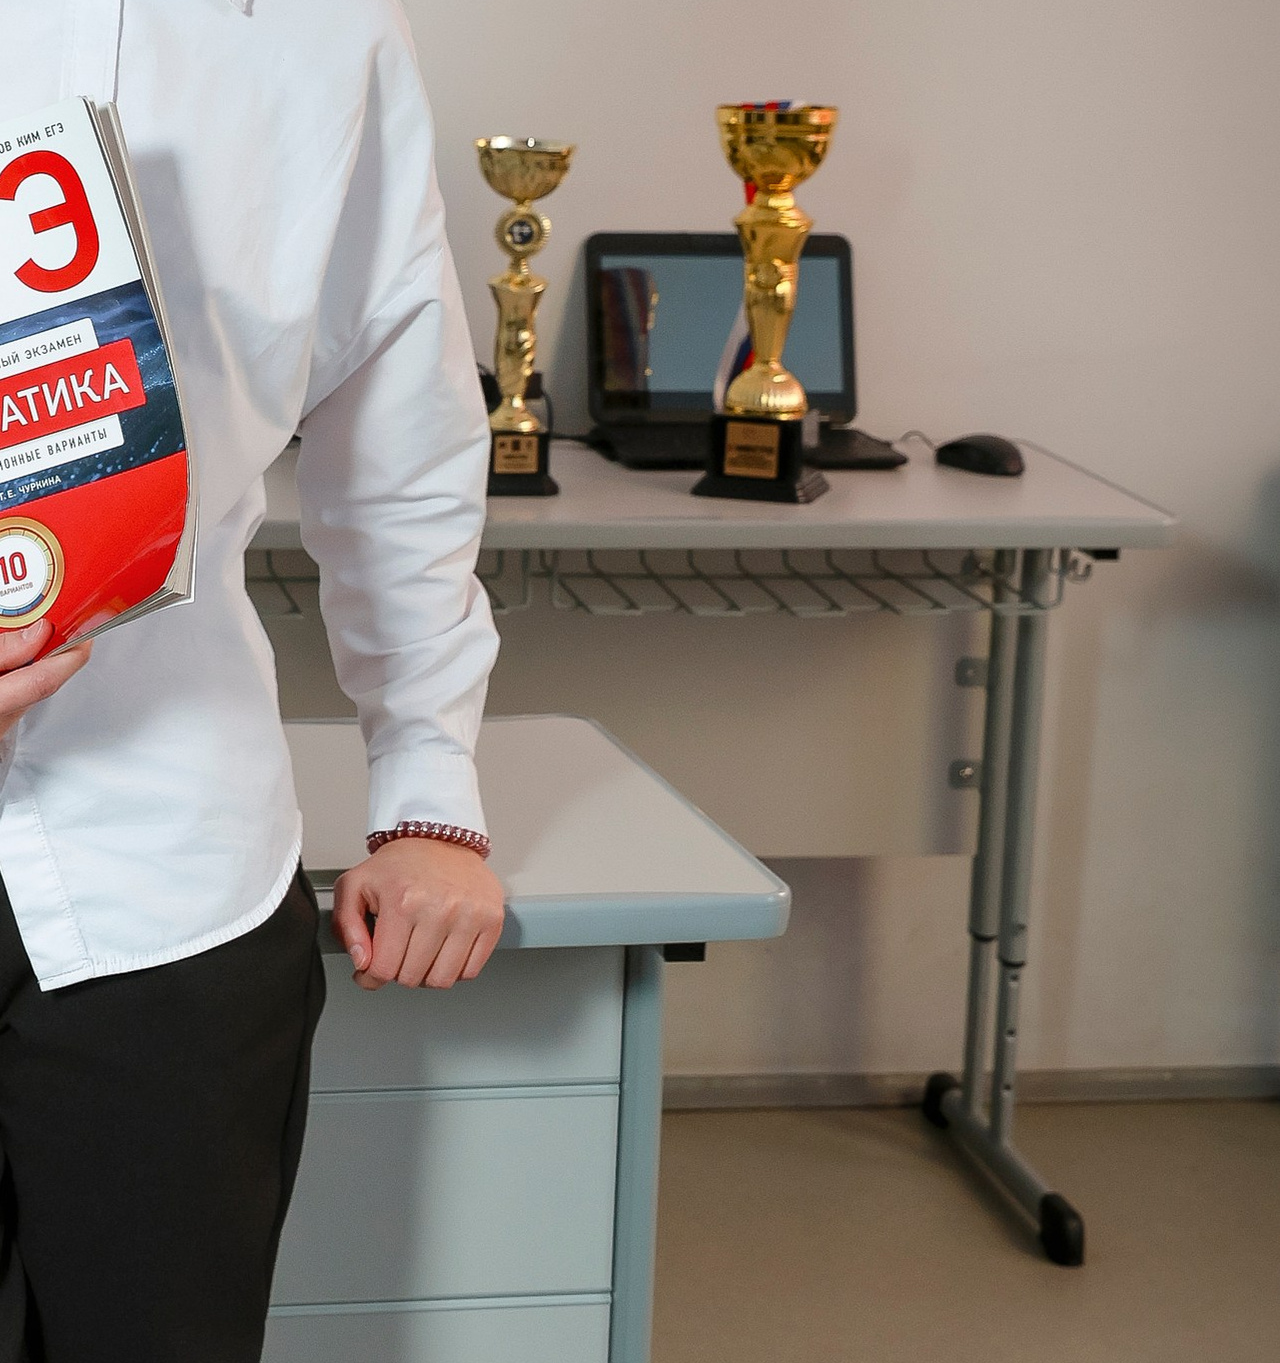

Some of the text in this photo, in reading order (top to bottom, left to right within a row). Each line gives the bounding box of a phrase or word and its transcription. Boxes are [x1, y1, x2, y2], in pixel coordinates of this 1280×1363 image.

[17, 130, 41, 148] КИМ
[45, 122, 65, 138] ЕГЭ
[25, 333, 83, 360] ЭКЗАМЕН
[47, 427, 108, 455] ВАРИАНТЫ
[18, 475, 62, 494] ЧУРКИНА
[0, 581, 34, 597] ВАРИАНТОВ
